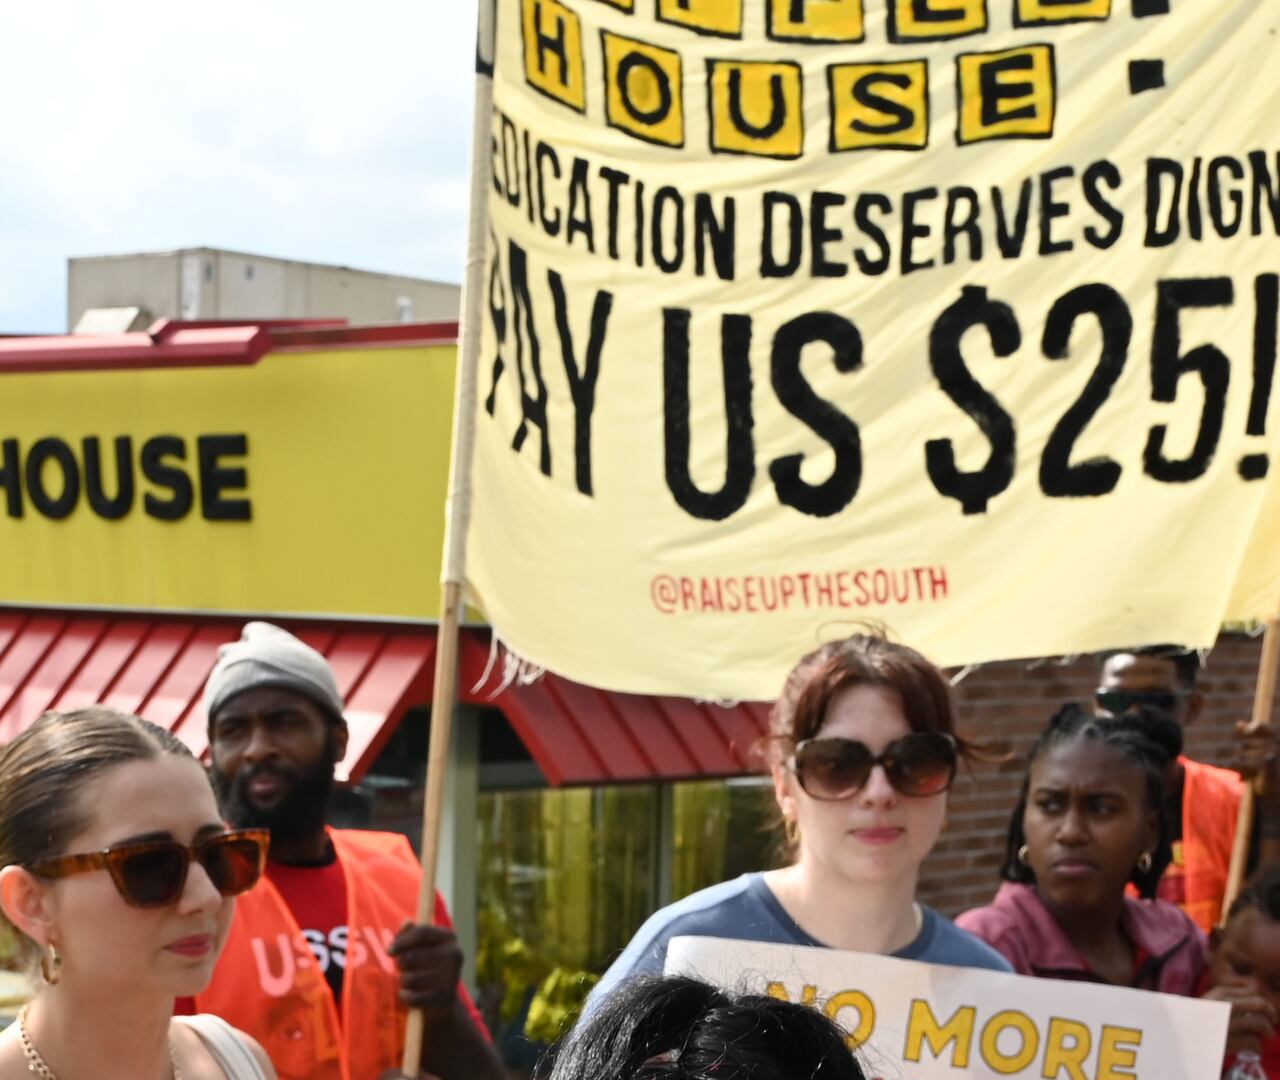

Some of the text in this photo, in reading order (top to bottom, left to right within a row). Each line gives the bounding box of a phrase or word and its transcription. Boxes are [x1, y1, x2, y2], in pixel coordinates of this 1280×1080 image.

[760, 160, 1122, 279] DESERVES
[486, 230, 1280, 520] PAY US $25!
[650, 566, 951, 615] @RAISEUPTHESOUTH
